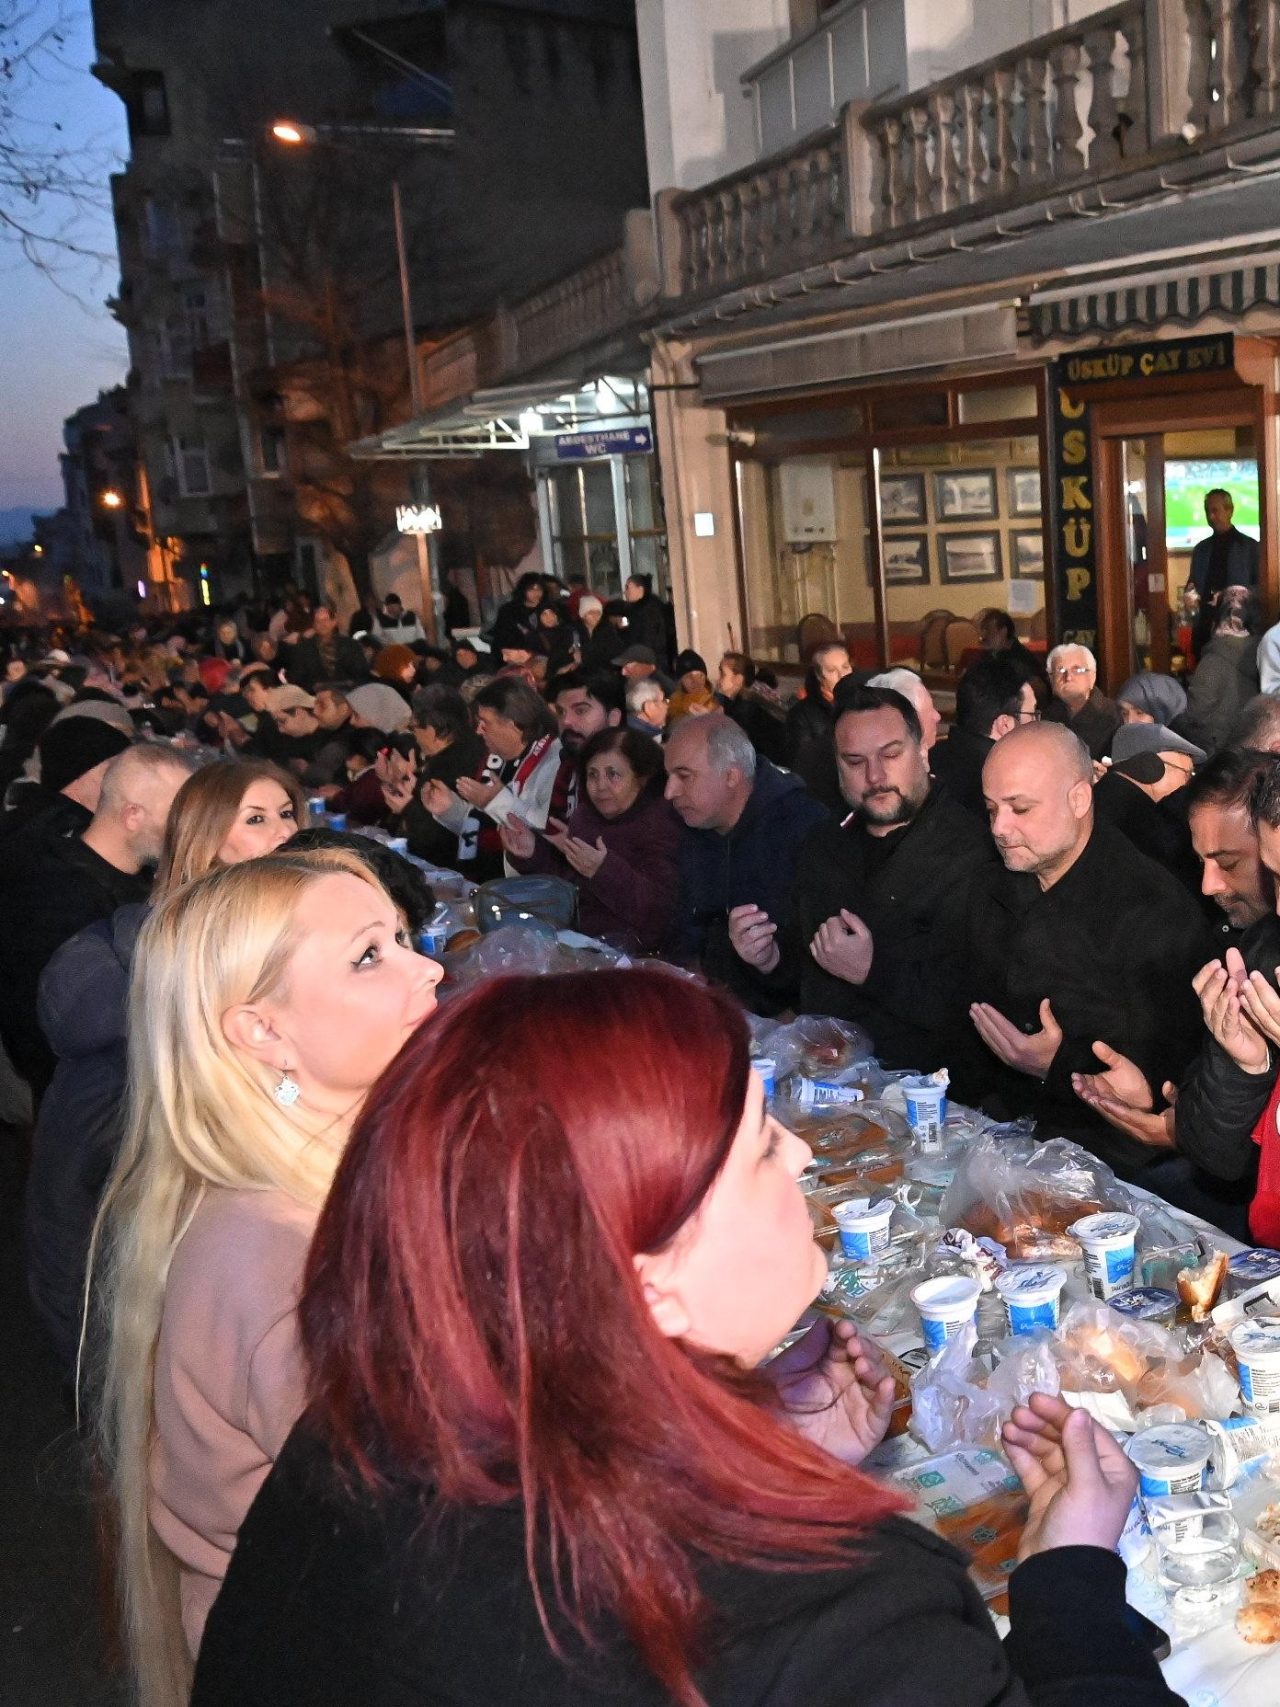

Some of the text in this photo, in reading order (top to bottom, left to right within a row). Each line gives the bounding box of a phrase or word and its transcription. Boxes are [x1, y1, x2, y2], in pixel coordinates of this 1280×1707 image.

[1067, 353, 1135, 381] ÜSKÜP
[1139, 350, 1181, 377] ÇAY
[585, 443, 607, 454] WC
